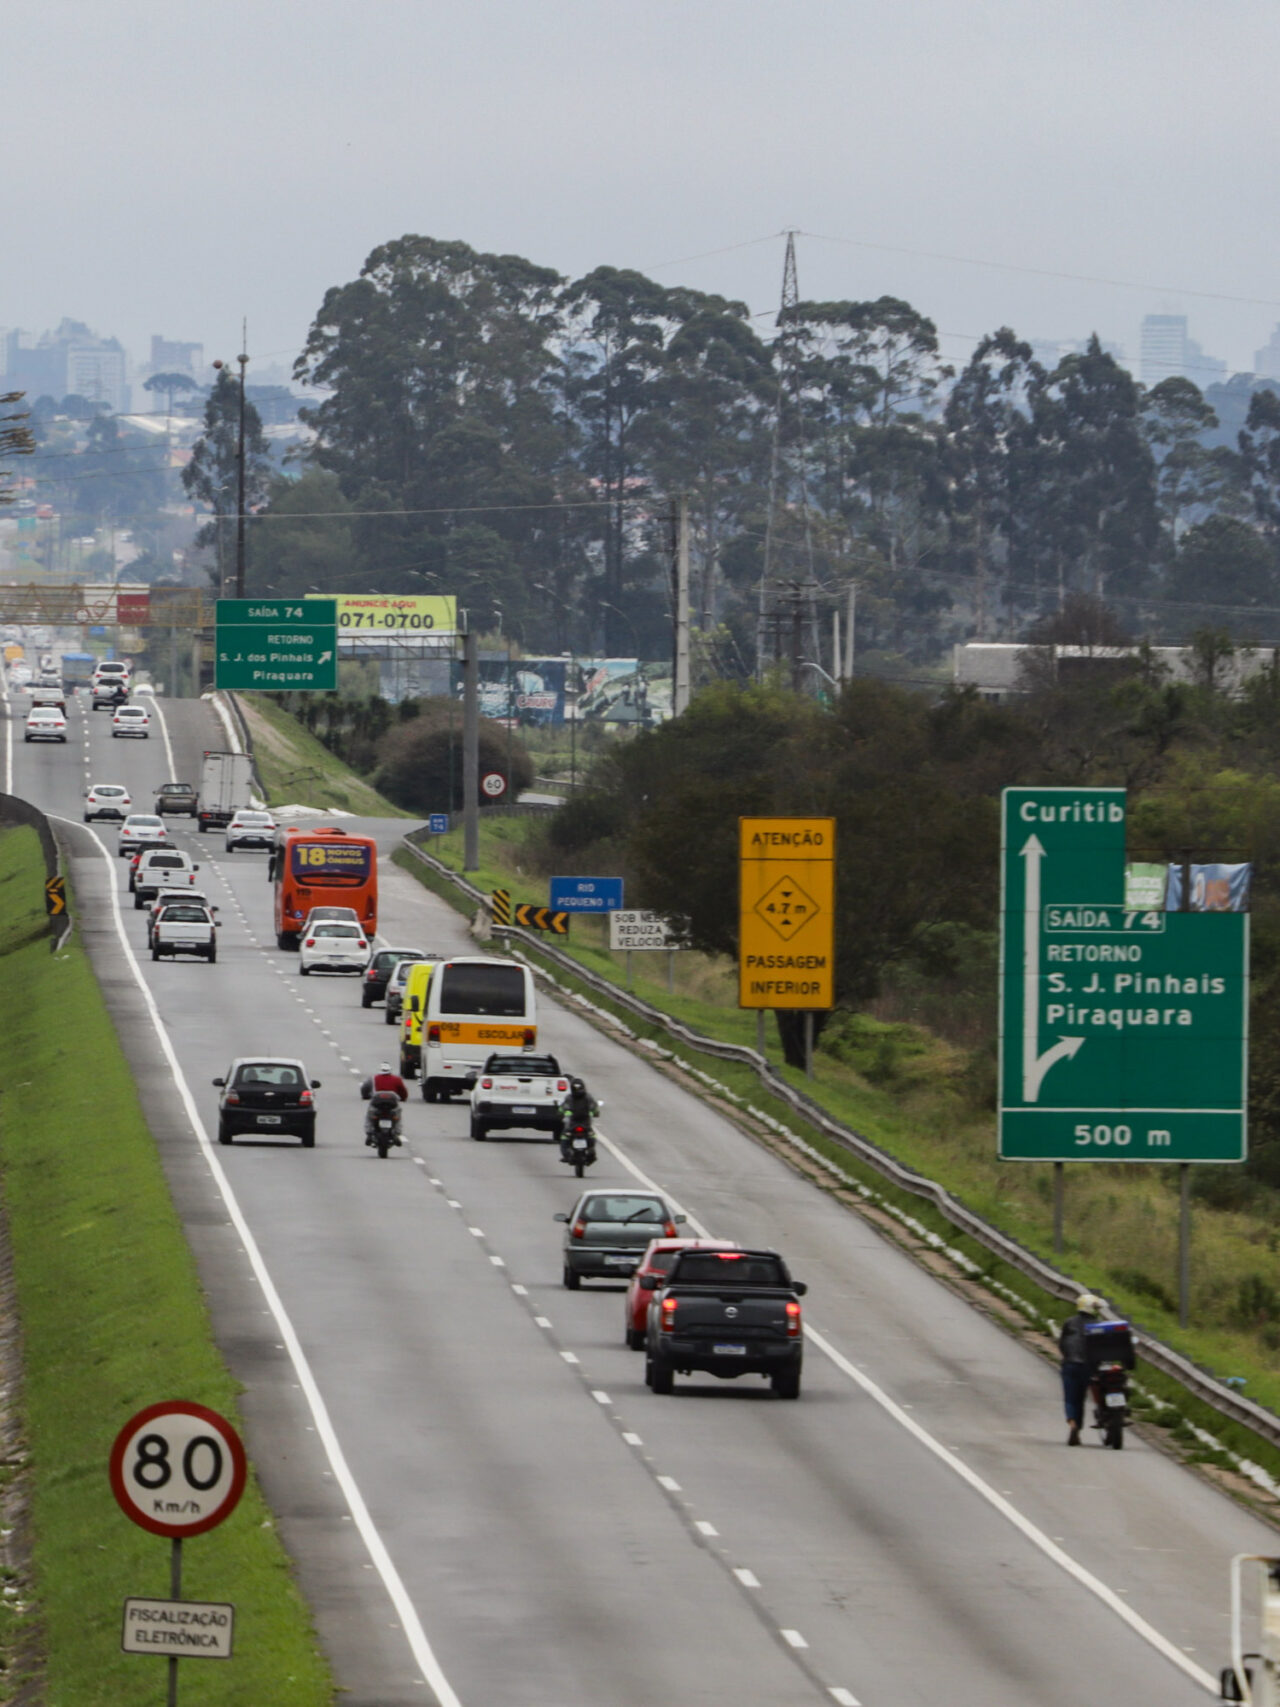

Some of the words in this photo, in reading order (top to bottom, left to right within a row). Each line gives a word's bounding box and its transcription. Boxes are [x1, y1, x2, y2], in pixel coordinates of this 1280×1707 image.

[248, 605, 279, 617] SAÍDA
[284, 607, 304, 618] 74
[344, 600, 389, 608] ANUNCIE
[391, 600, 417, 609] AQUI
[340, 612, 434, 629] 071-0700
[267, 634, 314, 645] RETORNO
[219, 652, 231, 662] S.
[233, 652, 244, 662] J.
[247, 653, 267, 662] dos
[269, 652, 314, 662] Pinhais
[252, 670, 314, 683] Piraquara
[487, 779, 502, 790] 60
[1019, 800, 1125, 823] Curitib
[751, 829, 824, 847] ATENÇÃO
[296, 847, 326, 866] 18
[327, 849, 363, 857] NOVOS
[326, 857, 366, 865] ÔNIBUS
[577, 883, 596, 893] RIO
[557, 897, 604, 907] PEQUENO
[765, 902, 791, 914] 4.7
[794, 904, 807, 914] m
[615, 913, 636, 923] SOB
[1049, 906, 1111, 928] SAÍDA
[1123, 911, 1161, 929] 74
[619, 925, 663, 935] REDUZA
[1047, 945, 1142, 962] RETORNO
[746, 955, 826, 969] PASSAGEM
[750, 980, 821, 995] INFERIOR
[1047, 972, 1073, 993] S.
[1082, 972, 1106, 993] J.
[1114, 972, 1226, 994] Pinhais
[1046, 1003, 1193, 1030] Piraquara
[1074, 1124, 1132, 1146] 500
[1147, 1129, 1172, 1146] m
[133, 1433, 223, 1491] 80
[153, 1499, 201, 1514] Km/h
[129, 1607, 228, 1627] FISCALIZAÇÃO
[135, 1628, 219, 1648] ELETRÔNICA
